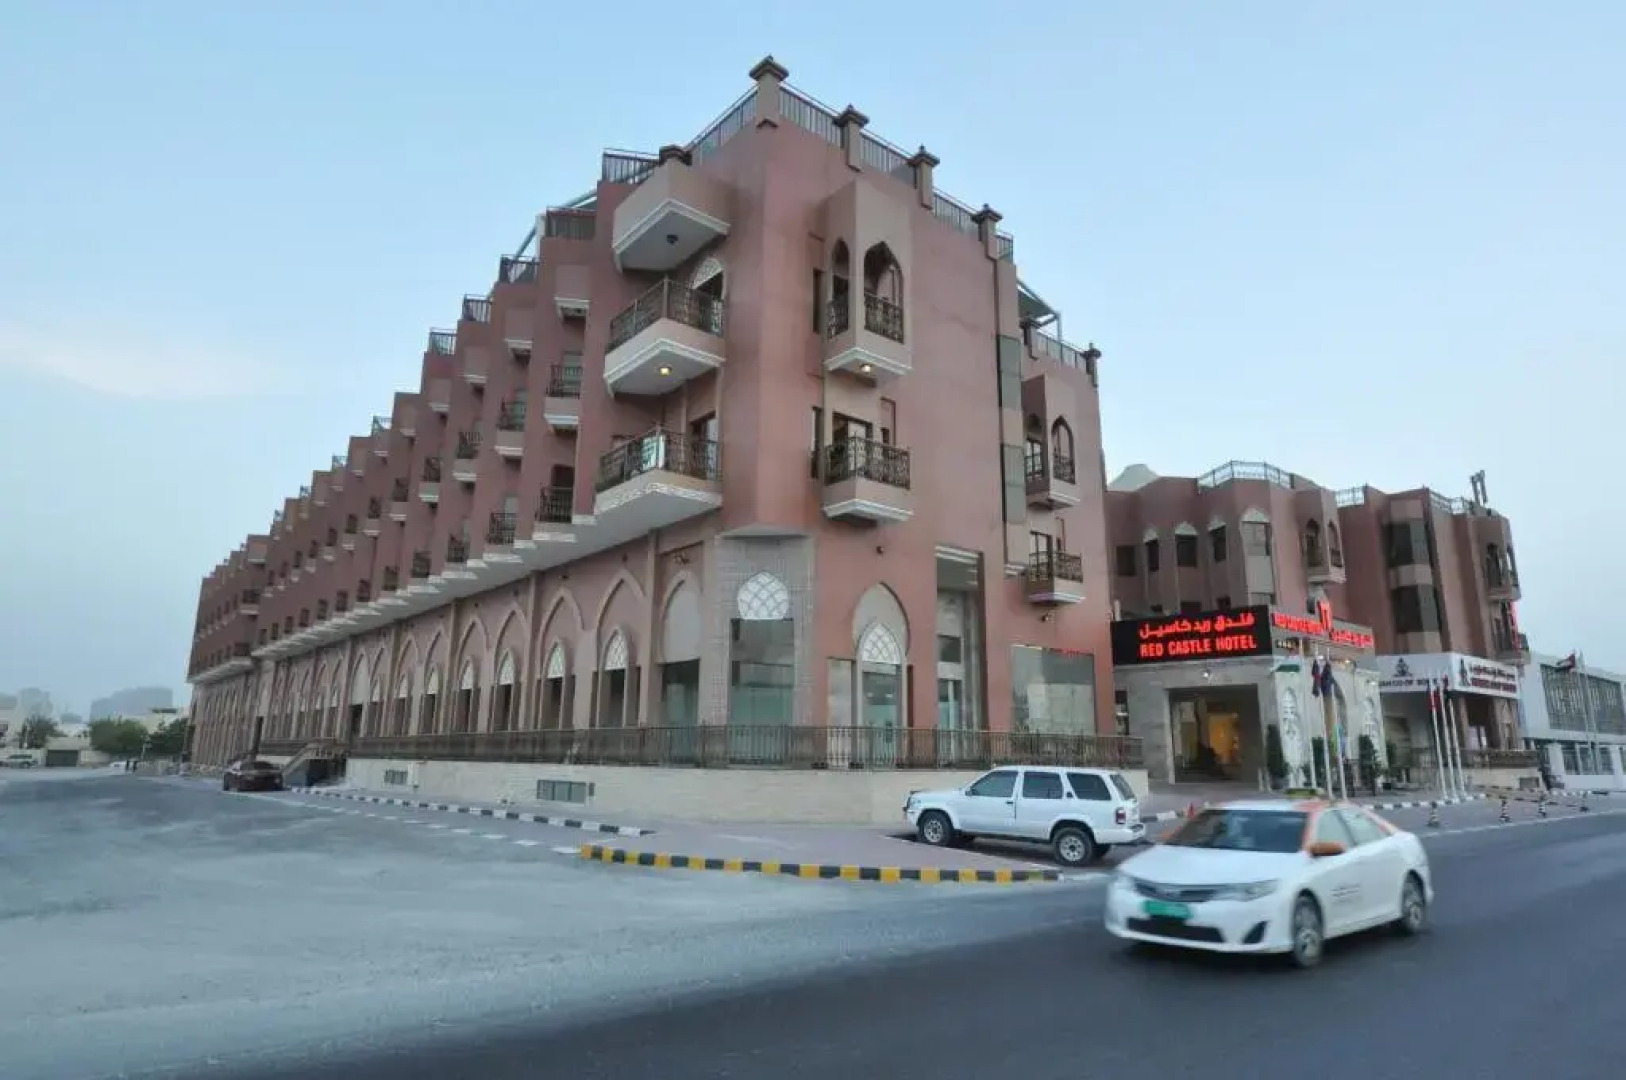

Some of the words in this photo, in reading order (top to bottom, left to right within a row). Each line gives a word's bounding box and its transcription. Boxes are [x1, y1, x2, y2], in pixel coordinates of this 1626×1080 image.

[1140, 619, 1191, 638] كاسيل
[1193, 619, 1211, 633] ريد
[1214, 612, 1255, 632] فندق
[1140, 642, 1164, 658] RED
[1168, 638, 1211, 655] CASTLE
[1215, 634, 1257, 651] HOTEL
